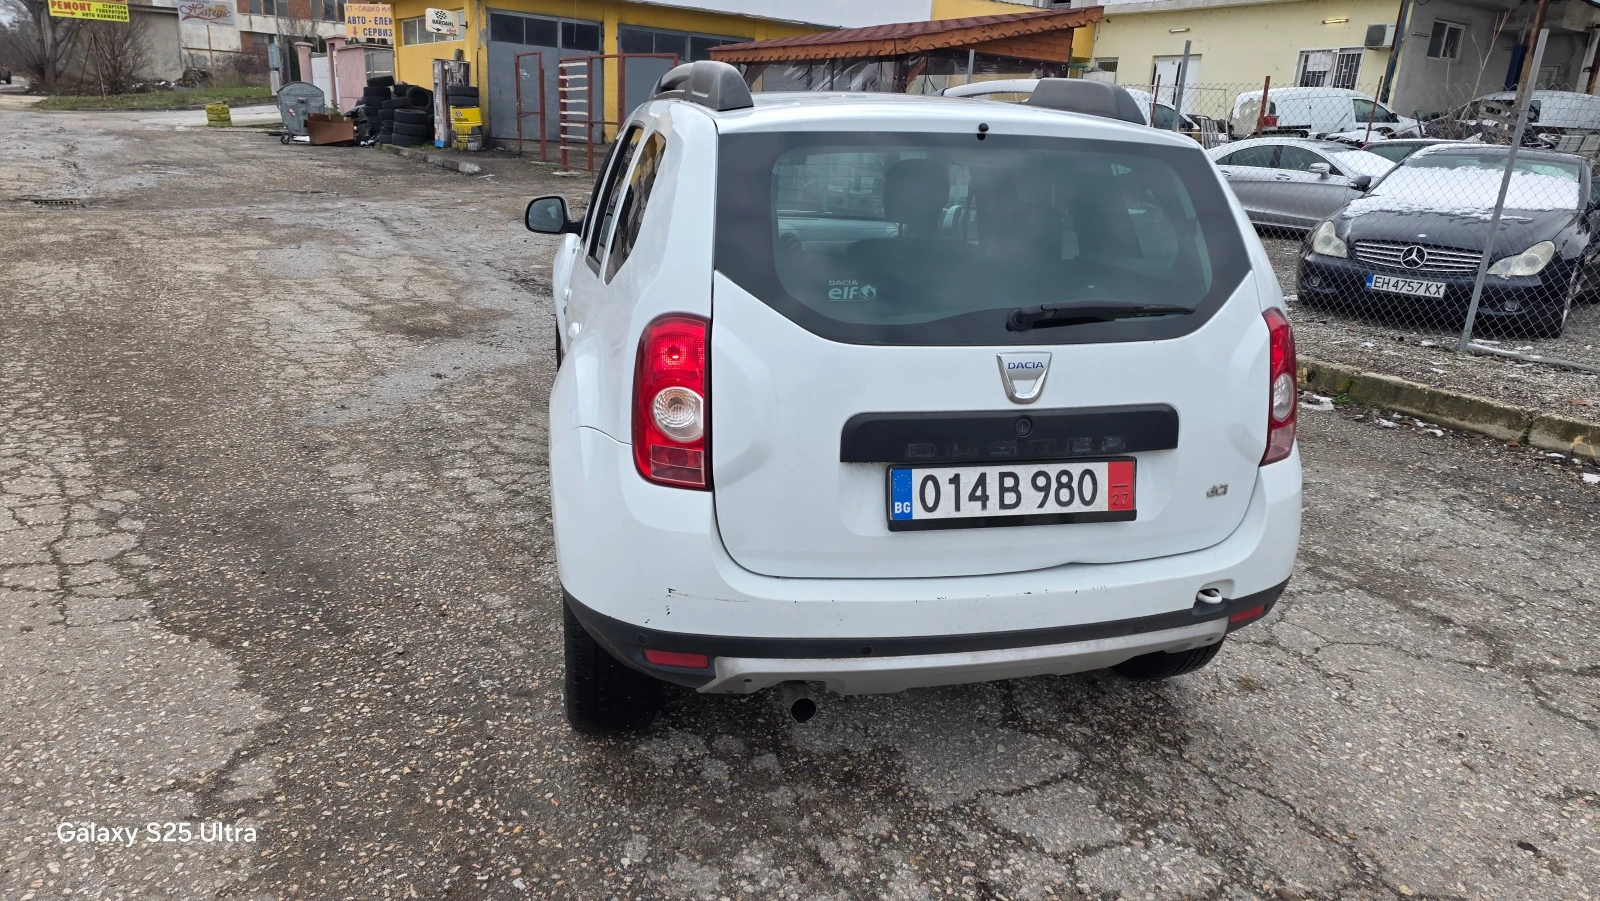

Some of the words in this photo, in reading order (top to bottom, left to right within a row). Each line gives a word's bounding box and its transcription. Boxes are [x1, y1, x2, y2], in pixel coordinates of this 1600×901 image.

[50, 0, 92, 12] РЕМОНТ
[347, 16, 366, 25] АВТО
[362, 27, 393, 37] СЕРВИЗ
[828, 286, 859, 300] elf
[1007, 361, 1044, 370] DACIA
[1112, 492, 1129, 506] 27
[894, 501, 911, 514] BG
